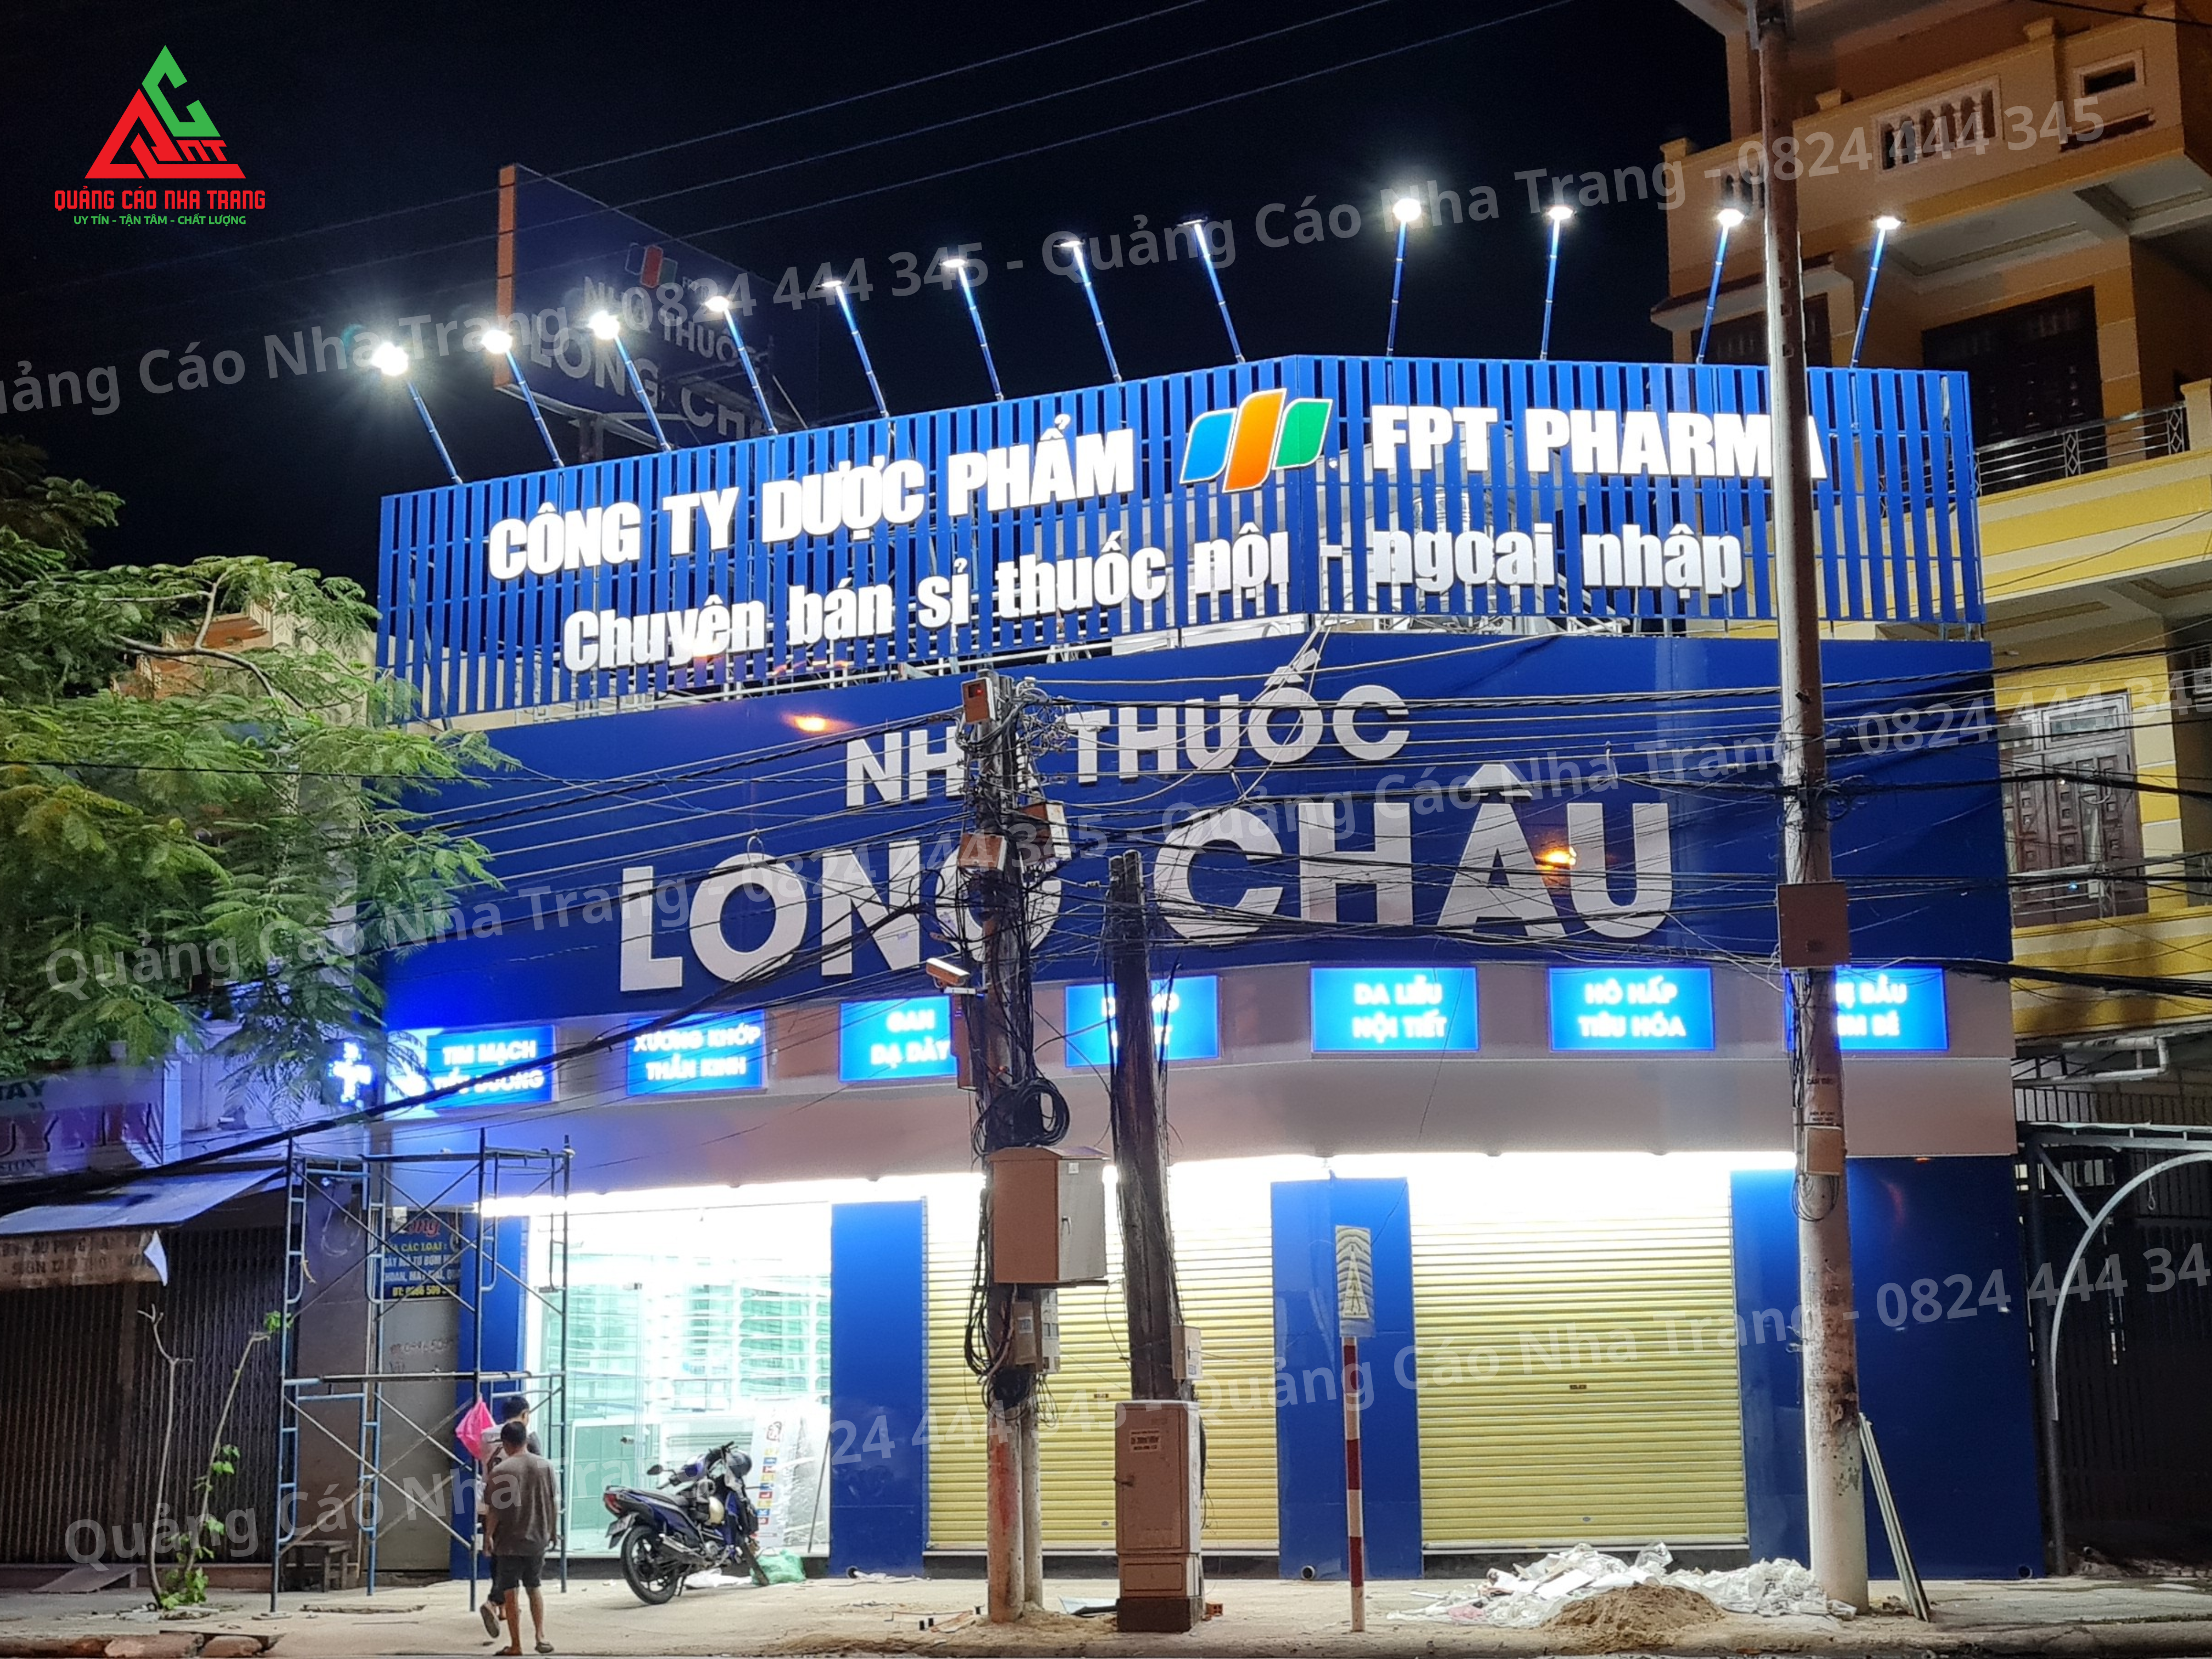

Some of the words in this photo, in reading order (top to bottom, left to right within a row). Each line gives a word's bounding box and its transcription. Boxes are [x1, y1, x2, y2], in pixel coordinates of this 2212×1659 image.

[489, 501, 641, 580] CÔNG
[663, 487, 740, 556] TY
[762, 455, 925, 543] DƯỢC
[948, 414, 1134, 517] PHẨM
[1372, 405, 1498, 471] FPT
[564, 595, 765, 672] Chuyên
[789, 578, 893, 646] bán
[918, 557, 969, 628] sỉ
[995, 531, 1166, 619] thuốc
[1194, 522, 1289, 599] nội
[1372, 523, 1554, 595] ngoại
[1582, 523, 1743, 599] nhập
[1065, 647, 1410, 785] THUỐC
[1154, 764, 1672, 944] CHÂU
[1353, 983, 1390, 1005] DA
[1584, 977, 1623, 1005] HÔ
[886, 1008, 936, 1033] GAN
[1352, 1013, 1398, 1043] NỘI
[1403, 1009, 1447, 1038] TIẾT
[1630, 1011, 1687, 1037] HÓA
[1871, 1009, 1900, 1036] BÉ
[633, 1029, 704, 1052] XƯƠNG
[707, 1022, 761, 1047] KHỚP
[442, 1045, 475, 1065] TIM
[478, 1040, 537, 1066] MẠCH
[700, 1056, 747, 1078] KINH
[870, 1043, 903, 1069] DẠ
[906, 1036, 951, 1063] DÀY
